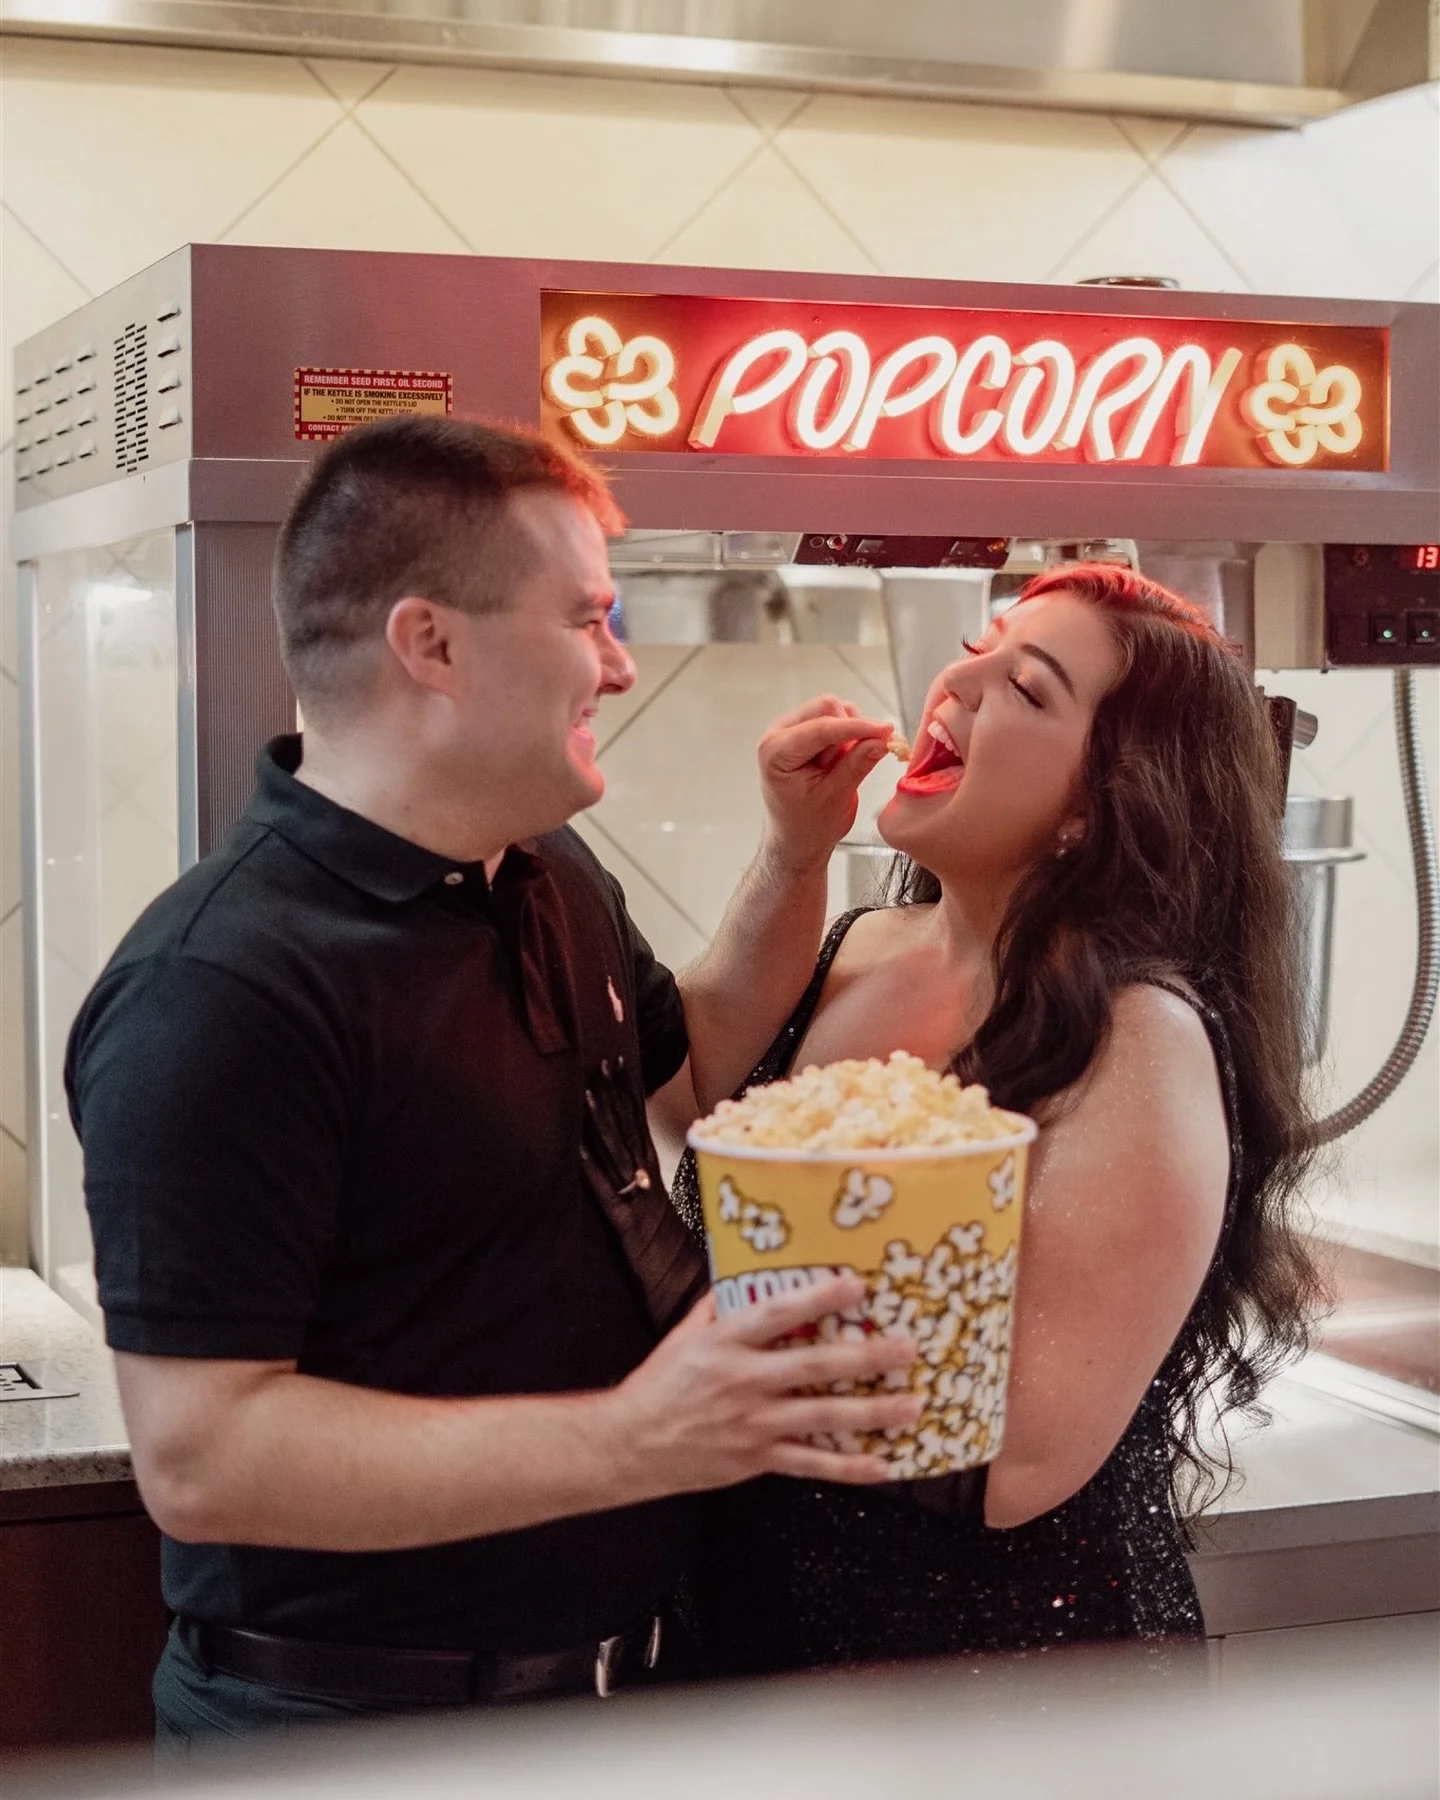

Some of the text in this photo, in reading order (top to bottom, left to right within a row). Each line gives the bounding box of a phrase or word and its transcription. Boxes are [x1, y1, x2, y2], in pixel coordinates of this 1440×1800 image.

[304, 375, 443, 388] REMEMBER SEED FIRST, OIL SECOND
[304, 388, 312, 396] IF
[312, 388, 326, 396] THE
[327, 389, 353, 397] KETTLE
[364, 391, 397, 399] SMOKING
[398, 392, 443, 401] EXCESSIVELY
[687, 328, 1242, 467] POPCORN
[308, 424, 340, 432] CONTACT
[1416, 546, 1439, 568] 13
